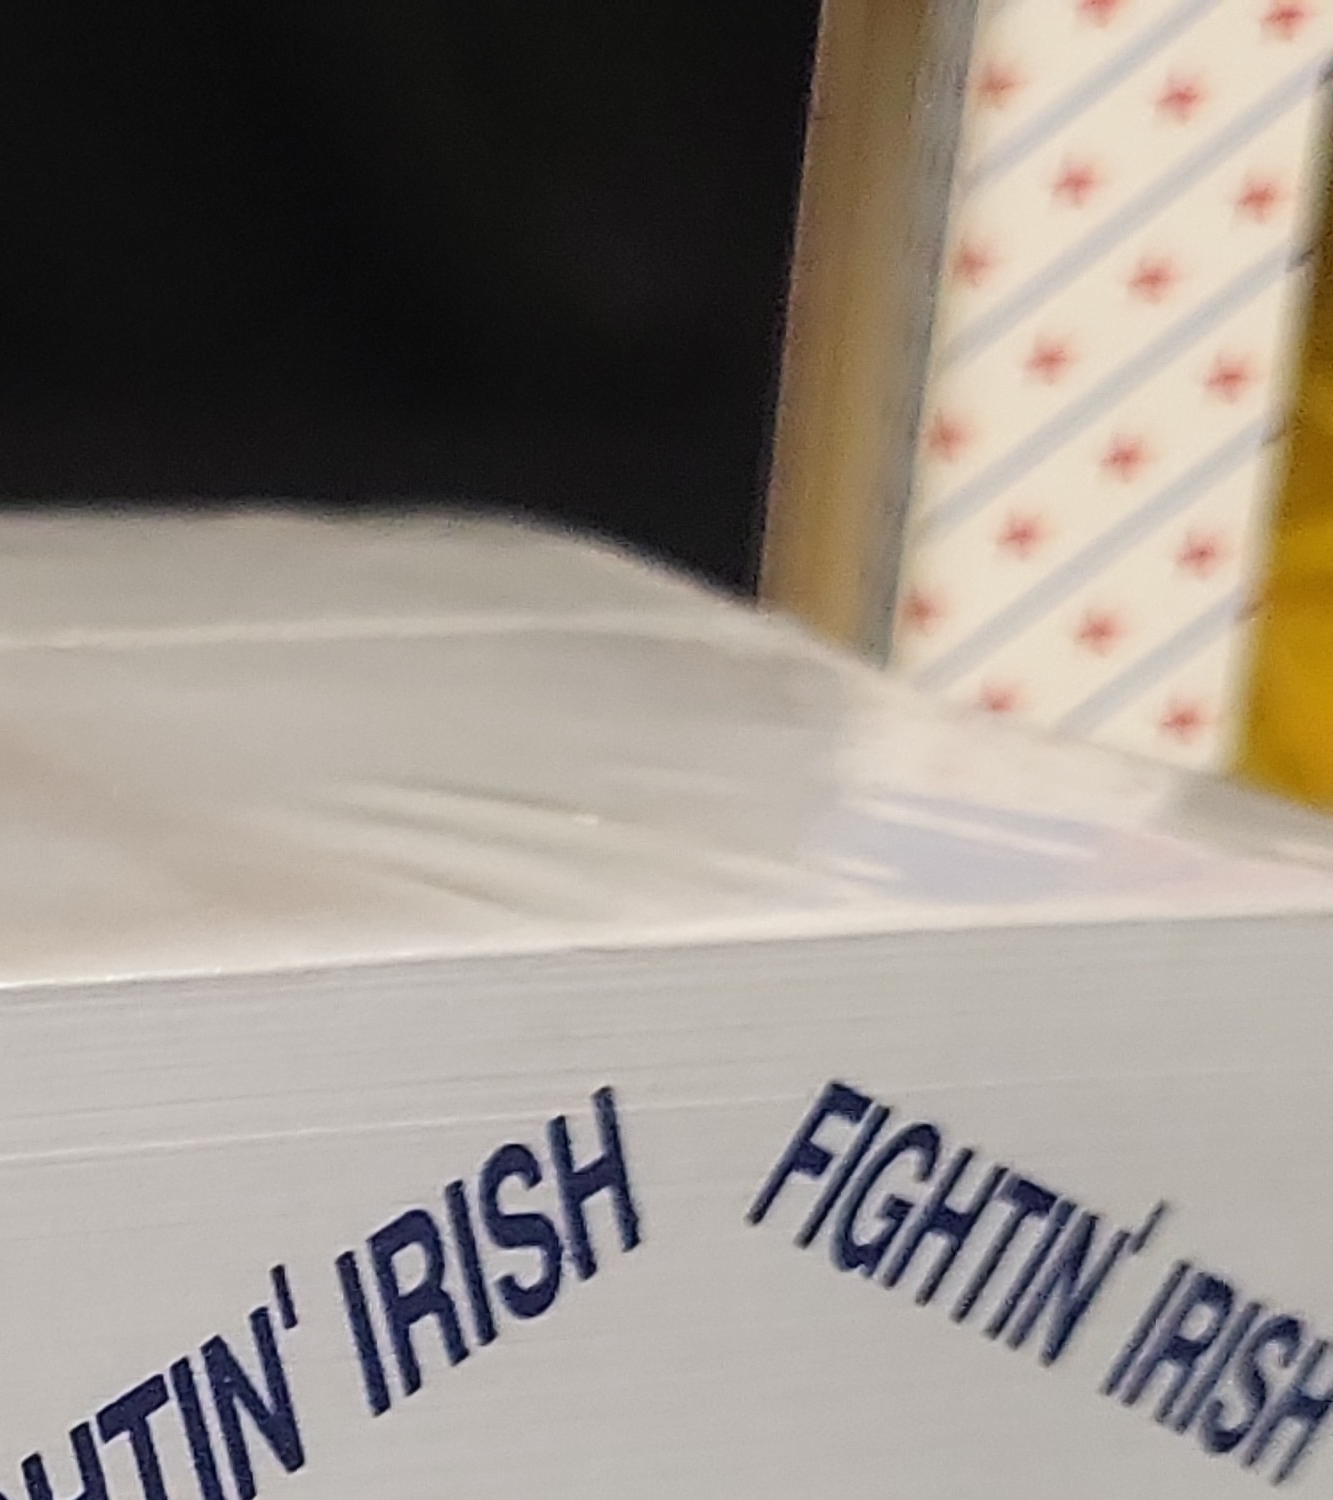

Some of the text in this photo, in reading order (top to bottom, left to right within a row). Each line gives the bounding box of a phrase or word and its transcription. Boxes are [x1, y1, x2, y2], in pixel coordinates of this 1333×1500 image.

[336, 1086, 645, 1418] IRISH
[743, 1078, 1333, 1486] FIGHTIN' IRISH
